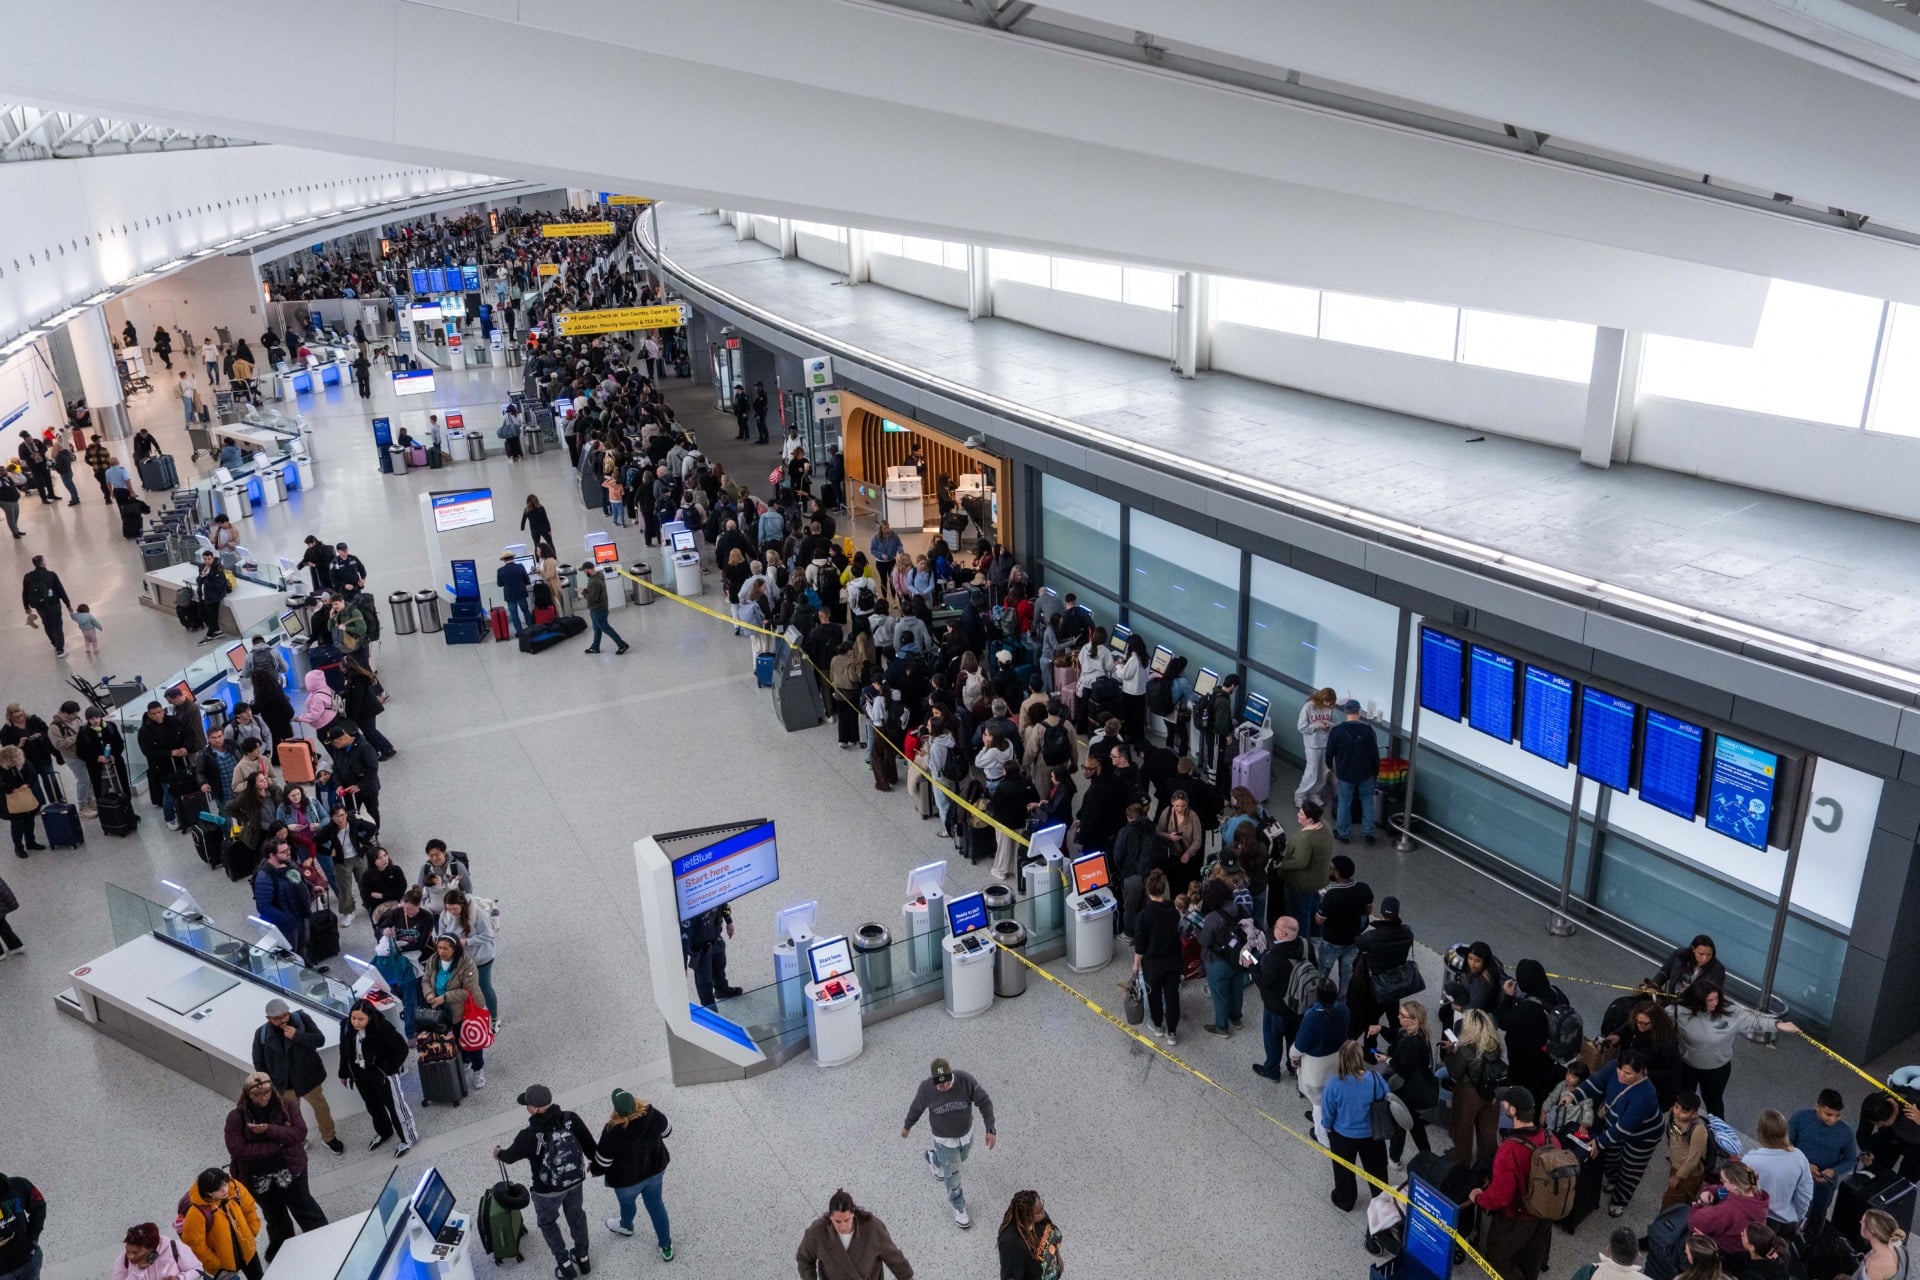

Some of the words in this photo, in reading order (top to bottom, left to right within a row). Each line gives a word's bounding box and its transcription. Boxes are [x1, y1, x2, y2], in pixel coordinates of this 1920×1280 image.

[436, 497, 455, 506] jetBlue
[439, 508, 452, 516] Start
[1496, 655, 1513, 666] jetBlue
[1552, 676, 1571, 688] jetBlue
[1612, 698, 1633, 711] jetBlue
[1311, 712, 1333, 722] CANAD
[1678, 723, 1700, 736] jetBlue
[682, 850, 713, 872] jetBlue
[685, 873, 708, 888] Start
[710, 864, 730, 878] here
[818, 956, 831, 965] Start
